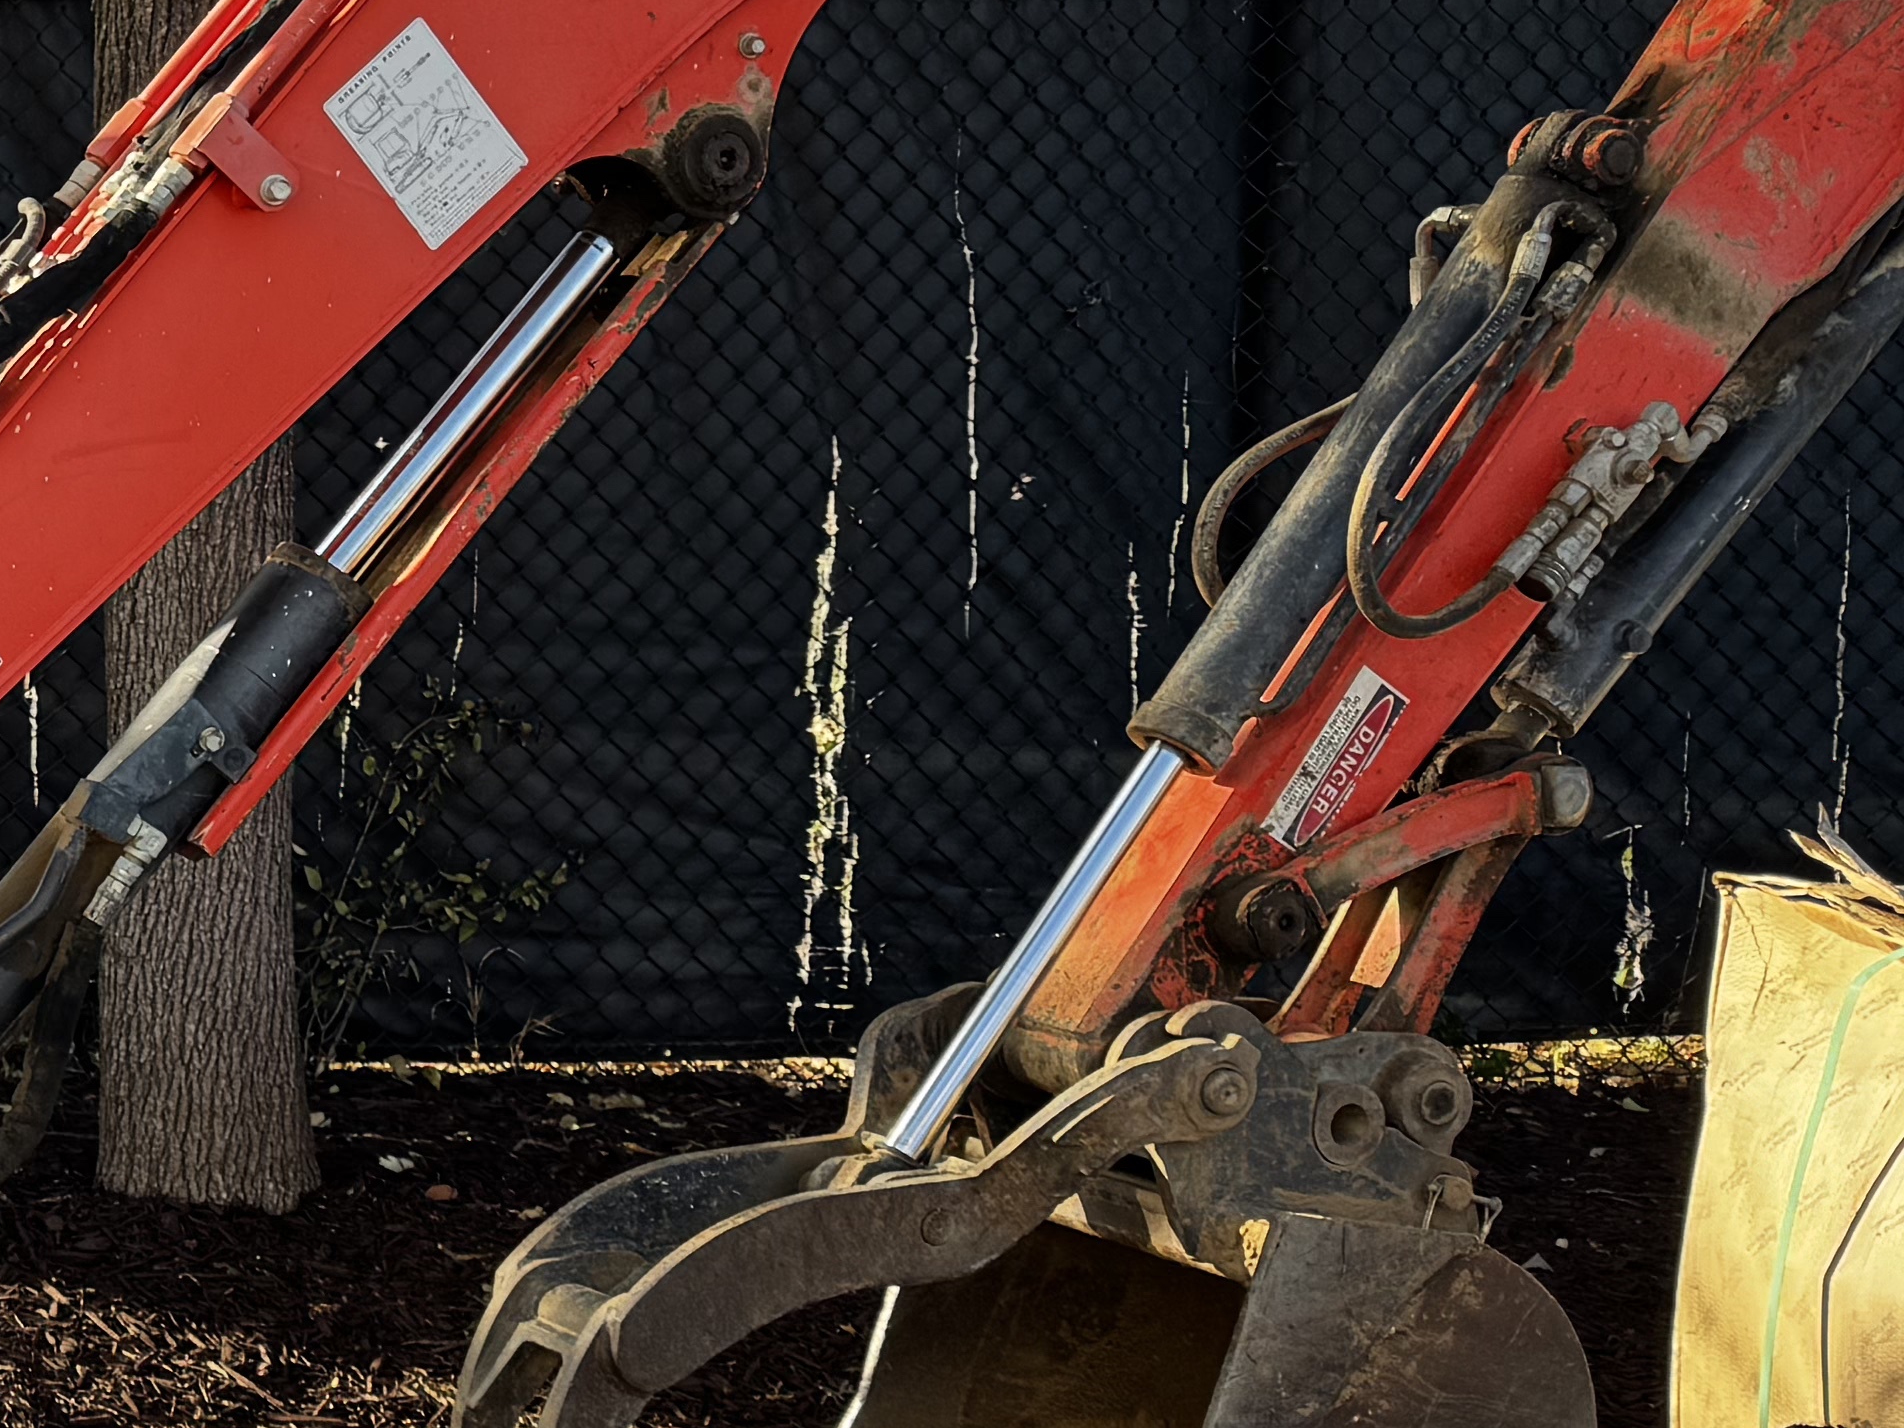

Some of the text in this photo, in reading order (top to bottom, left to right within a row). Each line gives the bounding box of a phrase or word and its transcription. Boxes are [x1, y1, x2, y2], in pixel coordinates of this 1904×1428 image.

[337, 34, 412, 104] GREASING POINTS
[1312, 724, 1376, 815] DANGER
